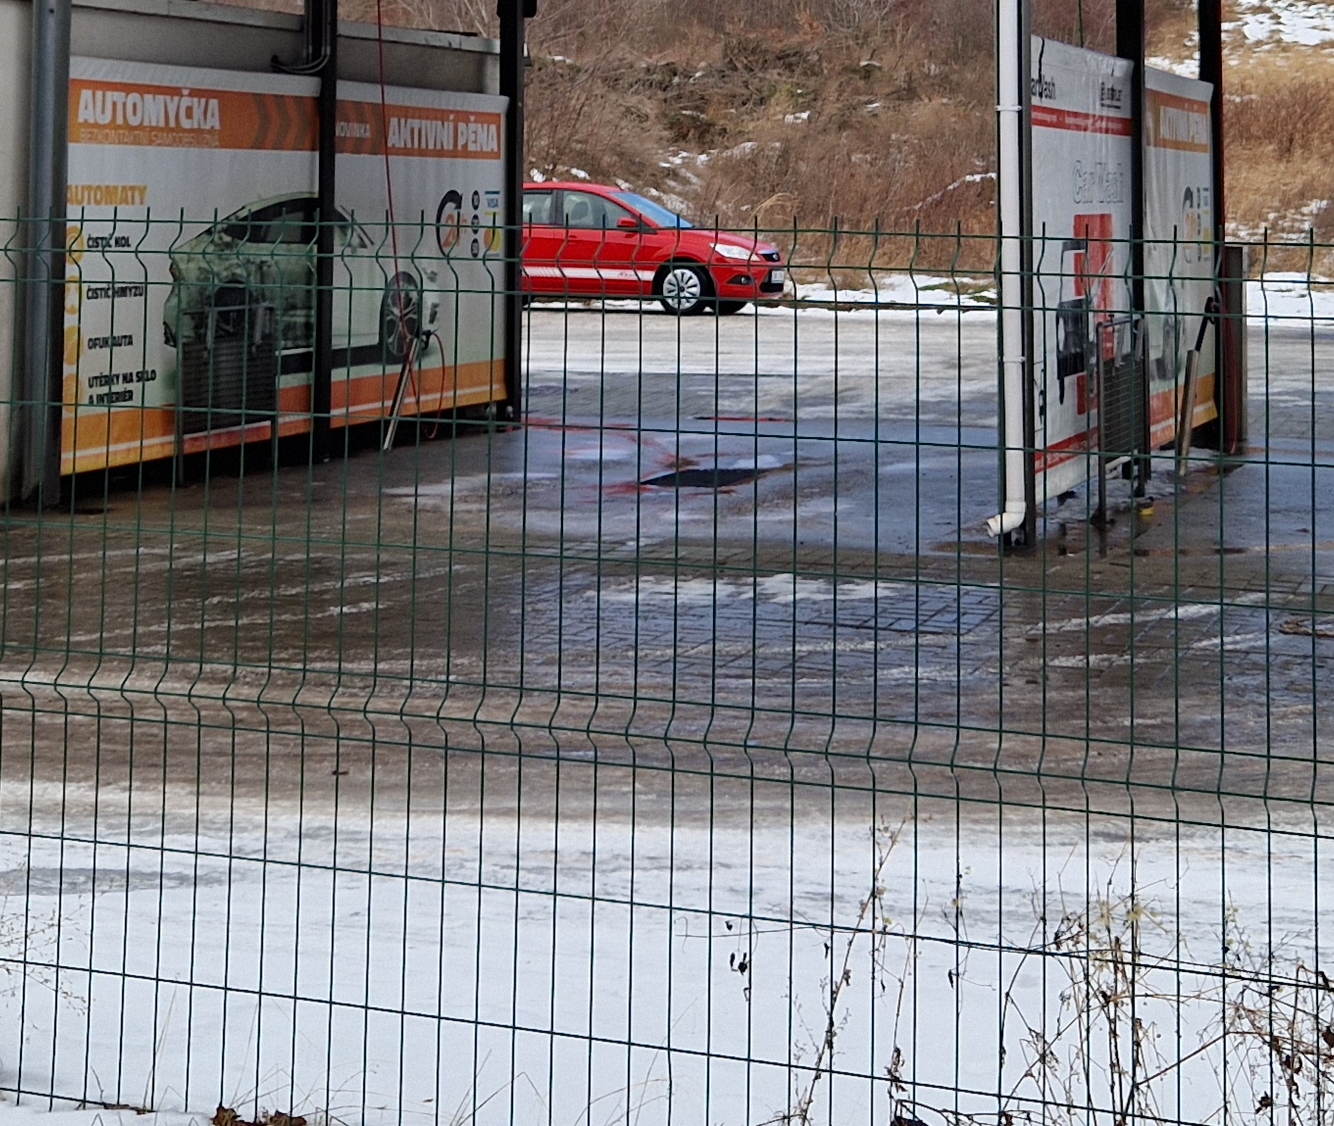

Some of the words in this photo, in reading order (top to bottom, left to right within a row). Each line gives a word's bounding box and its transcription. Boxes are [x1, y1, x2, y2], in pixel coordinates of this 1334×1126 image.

[78, 89, 221, 130] AUTOMYČKA
[388, 114, 455, 151] AKTIVNÍ
[458, 116, 499, 153] PĚNA
[115, 236, 131, 248] KOL
